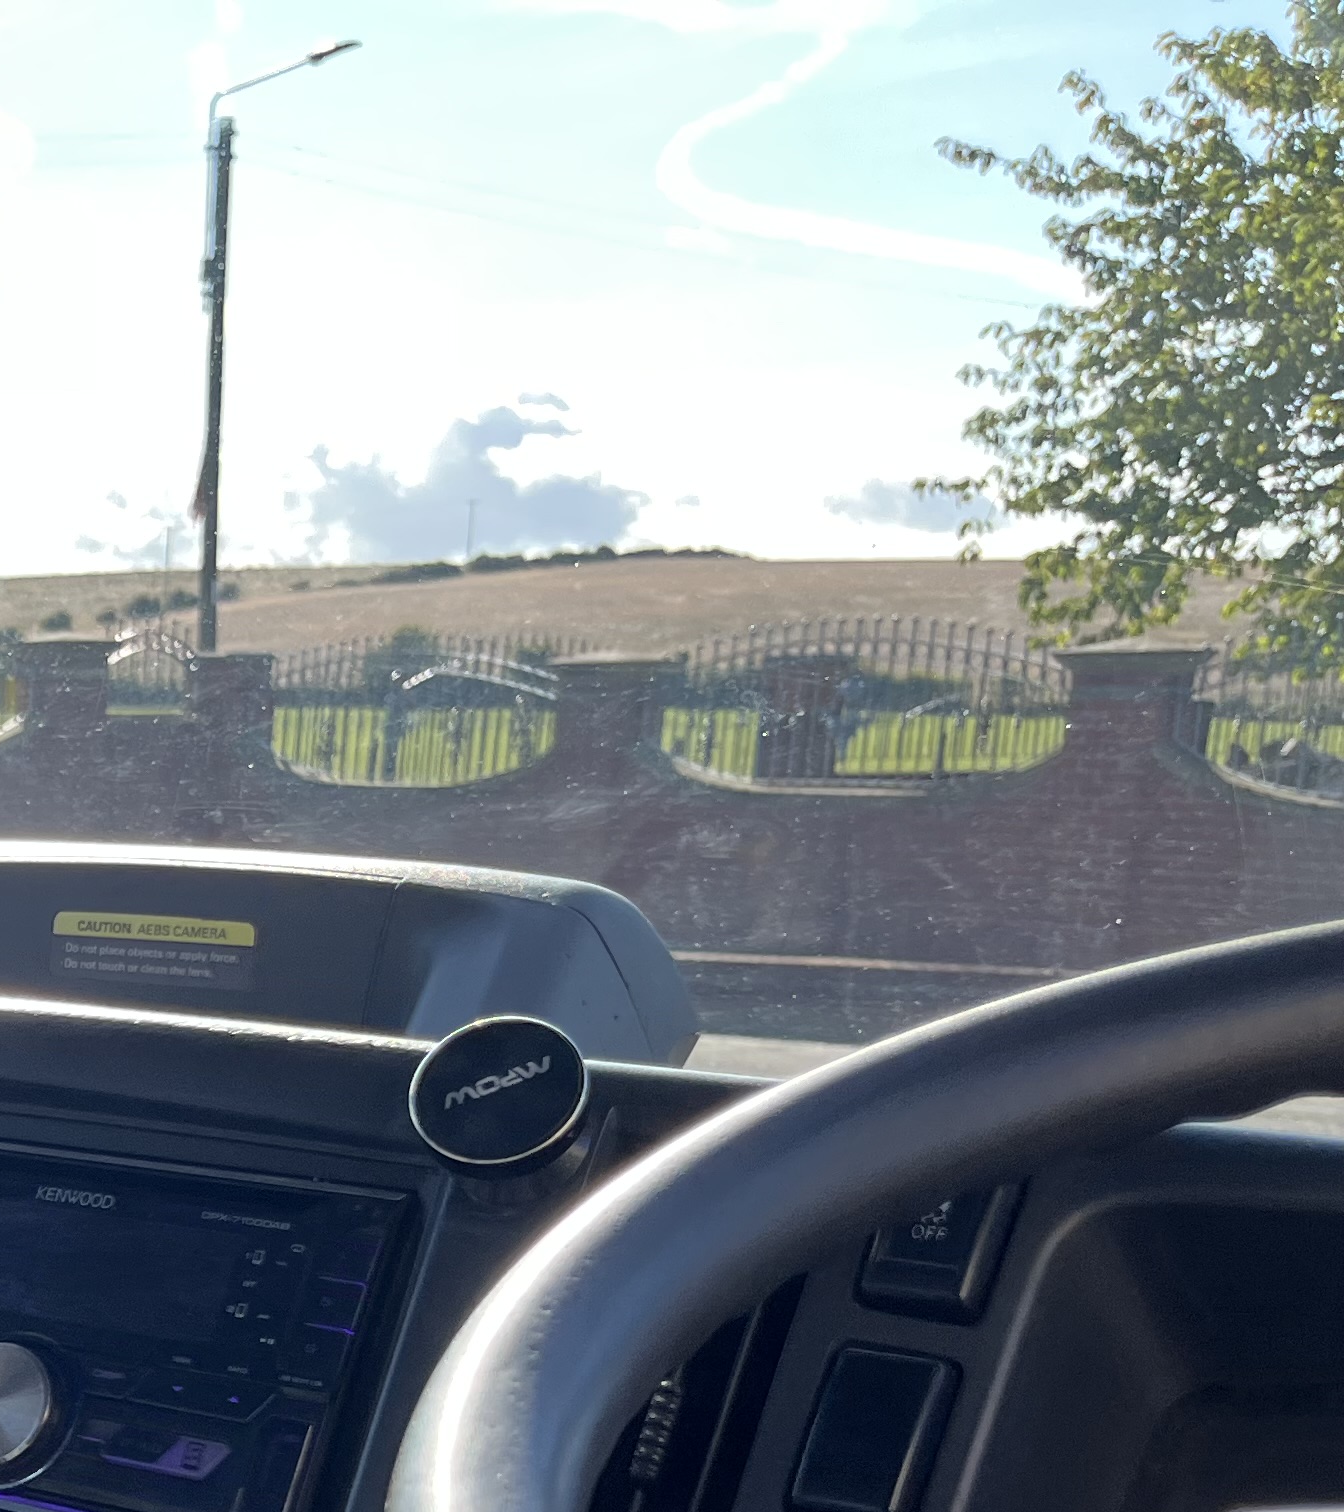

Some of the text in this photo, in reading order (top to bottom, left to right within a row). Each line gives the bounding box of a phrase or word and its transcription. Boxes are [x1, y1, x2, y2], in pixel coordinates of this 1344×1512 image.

[76, 919, 228, 940] CAUTION AEBS CAMERA
[64, 942, 79, 954] Do
[80, 944, 97, 955] not
[79, 959, 96, 970] not
[98, 960, 126, 972] touch
[444, 1055, 550, 1110] MPOW
[34, 1184, 117, 1210] KENWOOD
[911, 1223, 949, 1241] OFF
